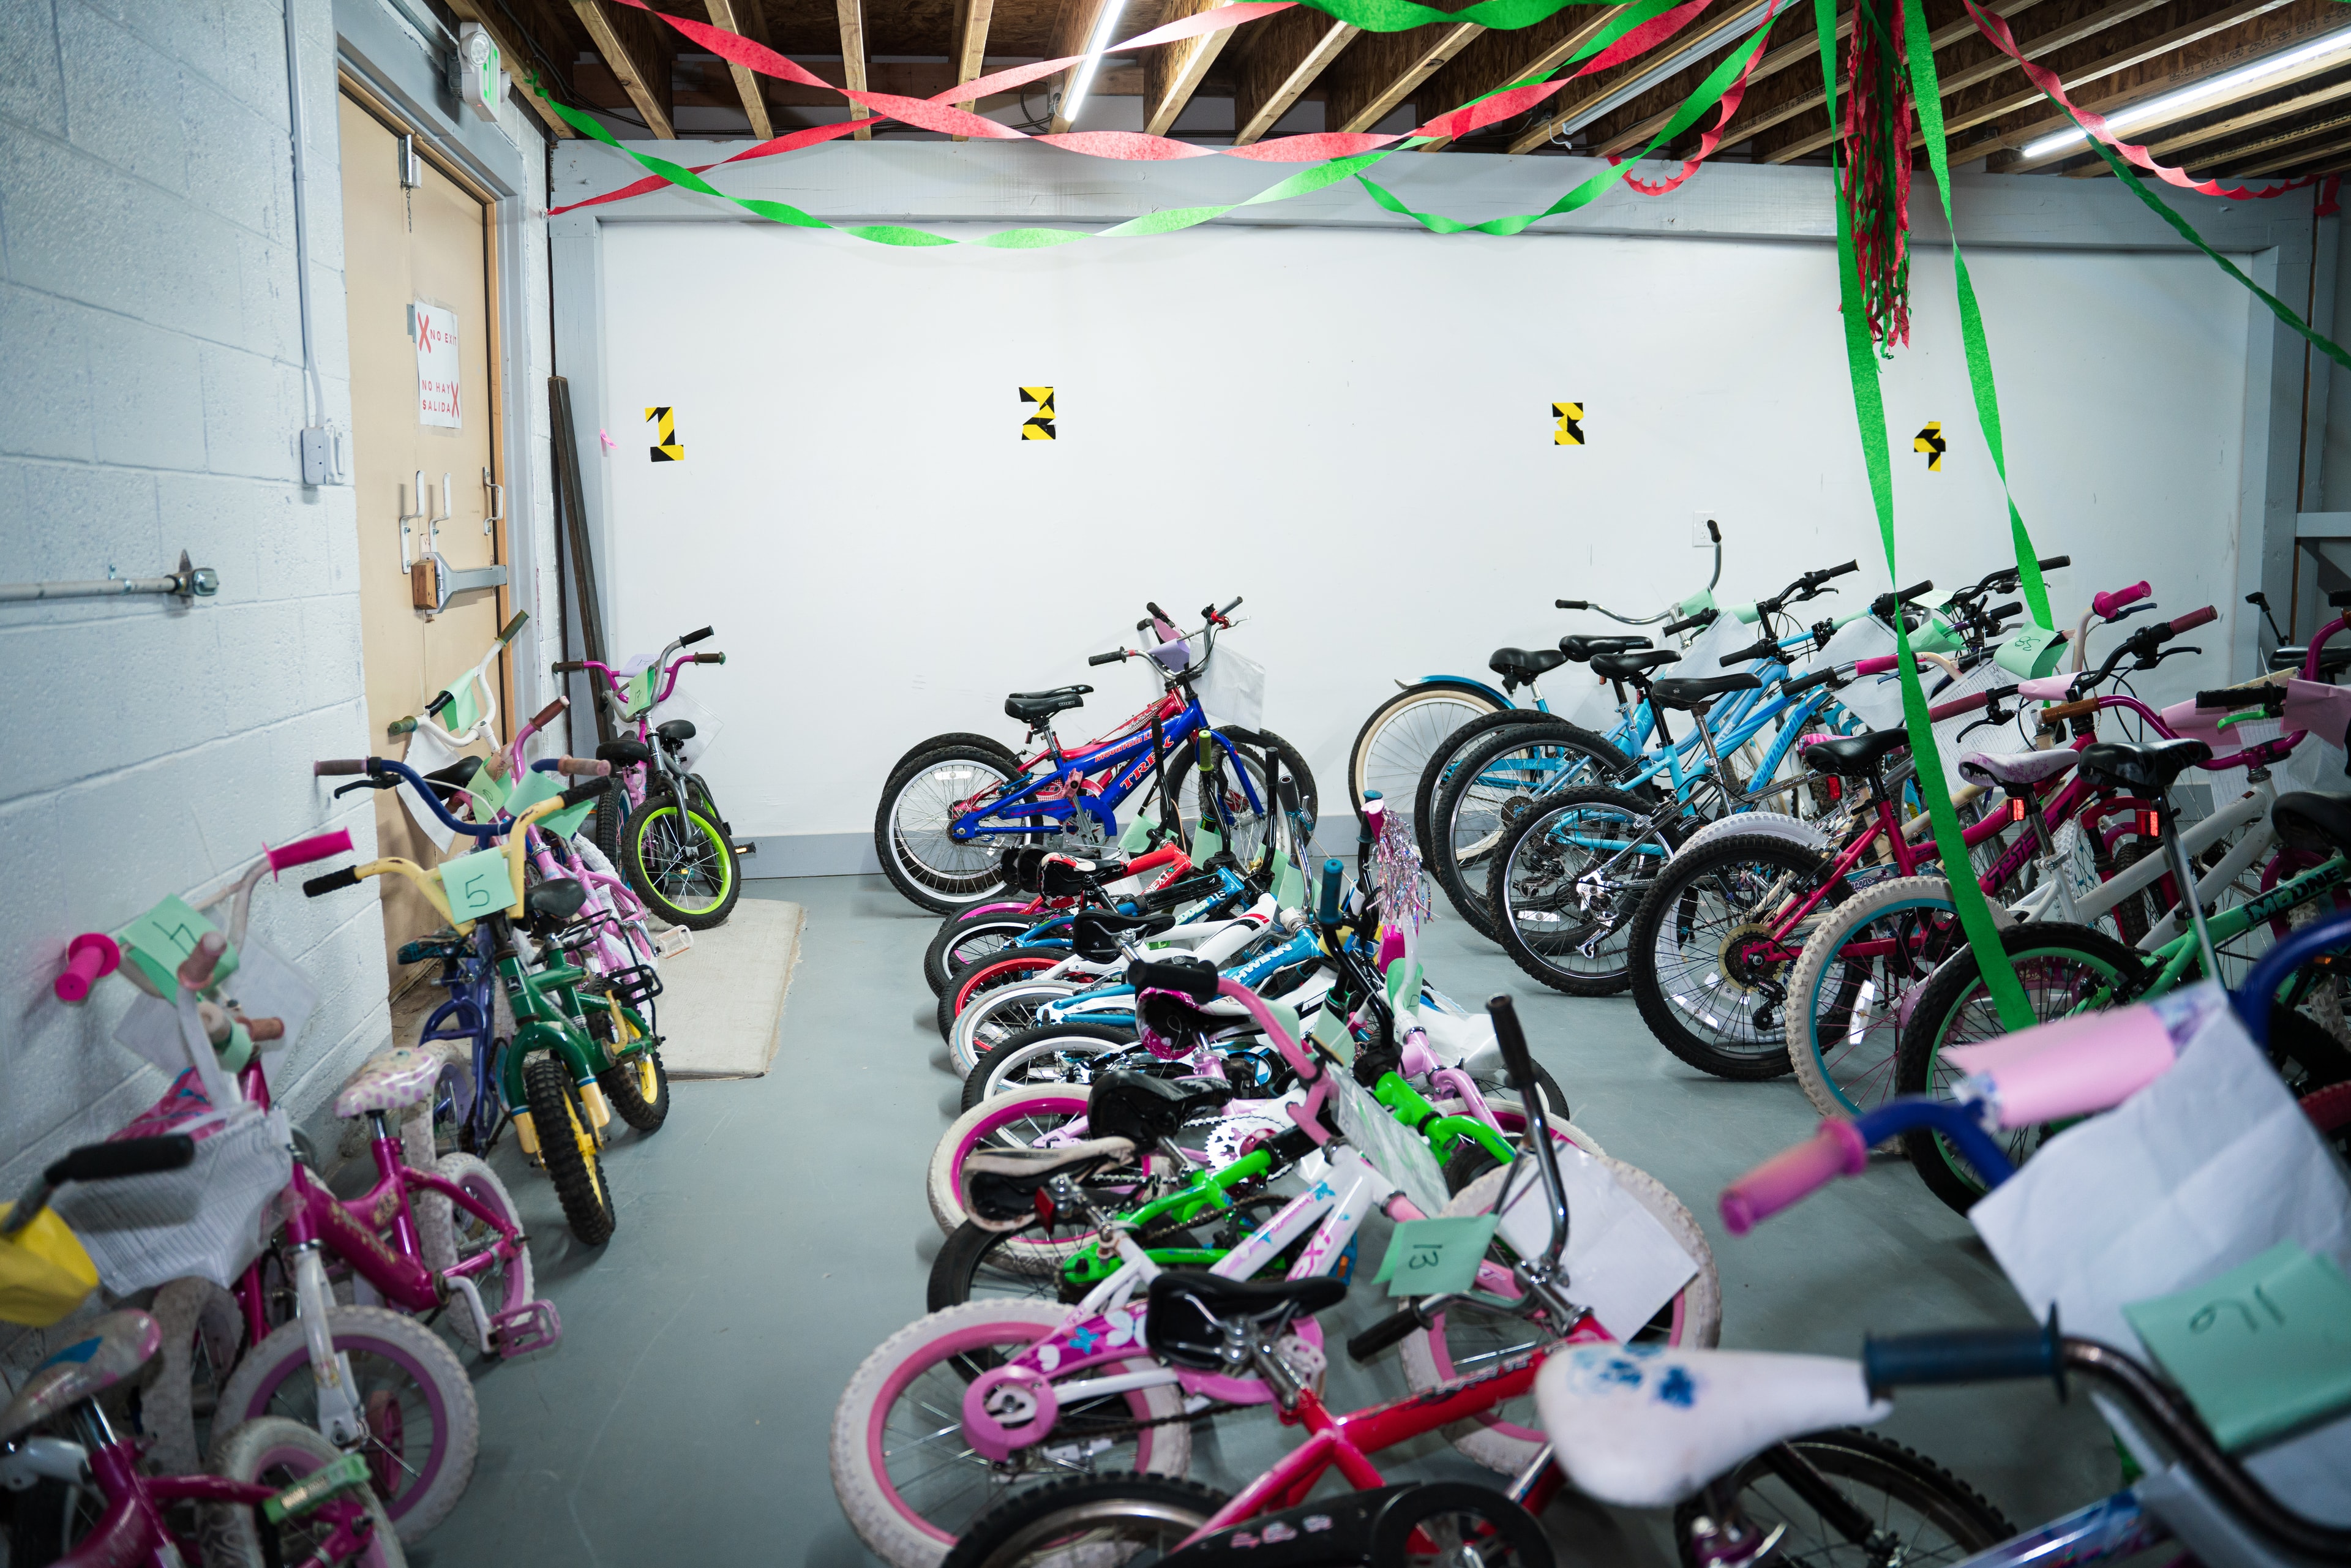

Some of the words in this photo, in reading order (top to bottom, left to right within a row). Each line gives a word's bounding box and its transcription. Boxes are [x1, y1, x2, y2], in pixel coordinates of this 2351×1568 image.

[430, 328, 441, 342] NO
[444, 332, 457, 346] EXIT
[422, 380, 432, 392] NO
[436, 381, 450, 394] HAY
[422, 399, 451, 413] SALIDA
[1018, 386, 1056, 440] 2
[645, 406, 684, 462] 1
[1551, 402, 1585, 445] 3
[1914, 421, 1946, 473] 4
[1095, 737, 1142, 763] Mountain
[465, 874, 489, 908] 5
[1144, 871, 1170, 894] NEXT
[1218, 943, 1293, 983] HWINN
[1409, 1244, 1443, 1270] 13
